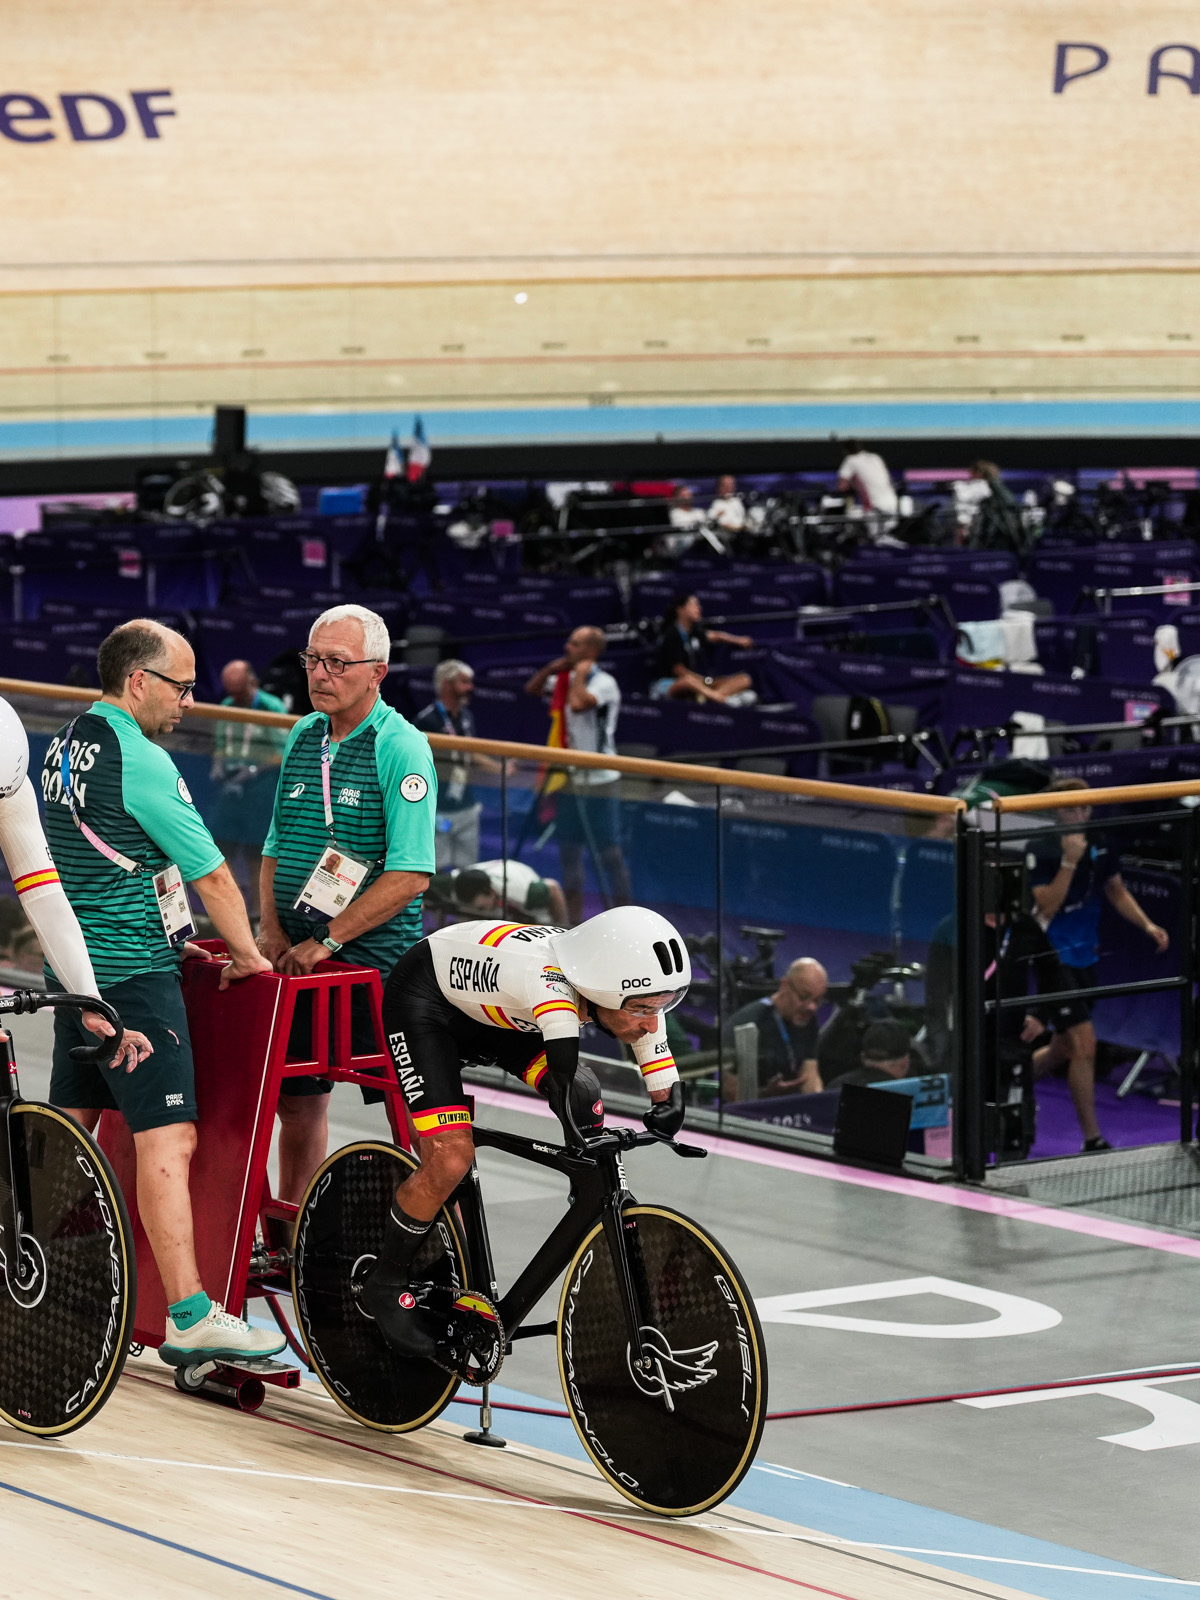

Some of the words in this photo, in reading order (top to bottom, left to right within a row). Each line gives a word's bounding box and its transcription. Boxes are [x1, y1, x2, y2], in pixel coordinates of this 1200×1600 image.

[449, 956, 500, 993] ESPAÑA
[388, 1031, 425, 1105] ESPAÑA
[65, 1153, 121, 1414] CAMPAGNOLO
[171, 1310, 193, 1319] 2024
[564, 1248, 640, 1490] CAMPAGNOLO
[713, 1274, 753, 1420] GHIBLI
